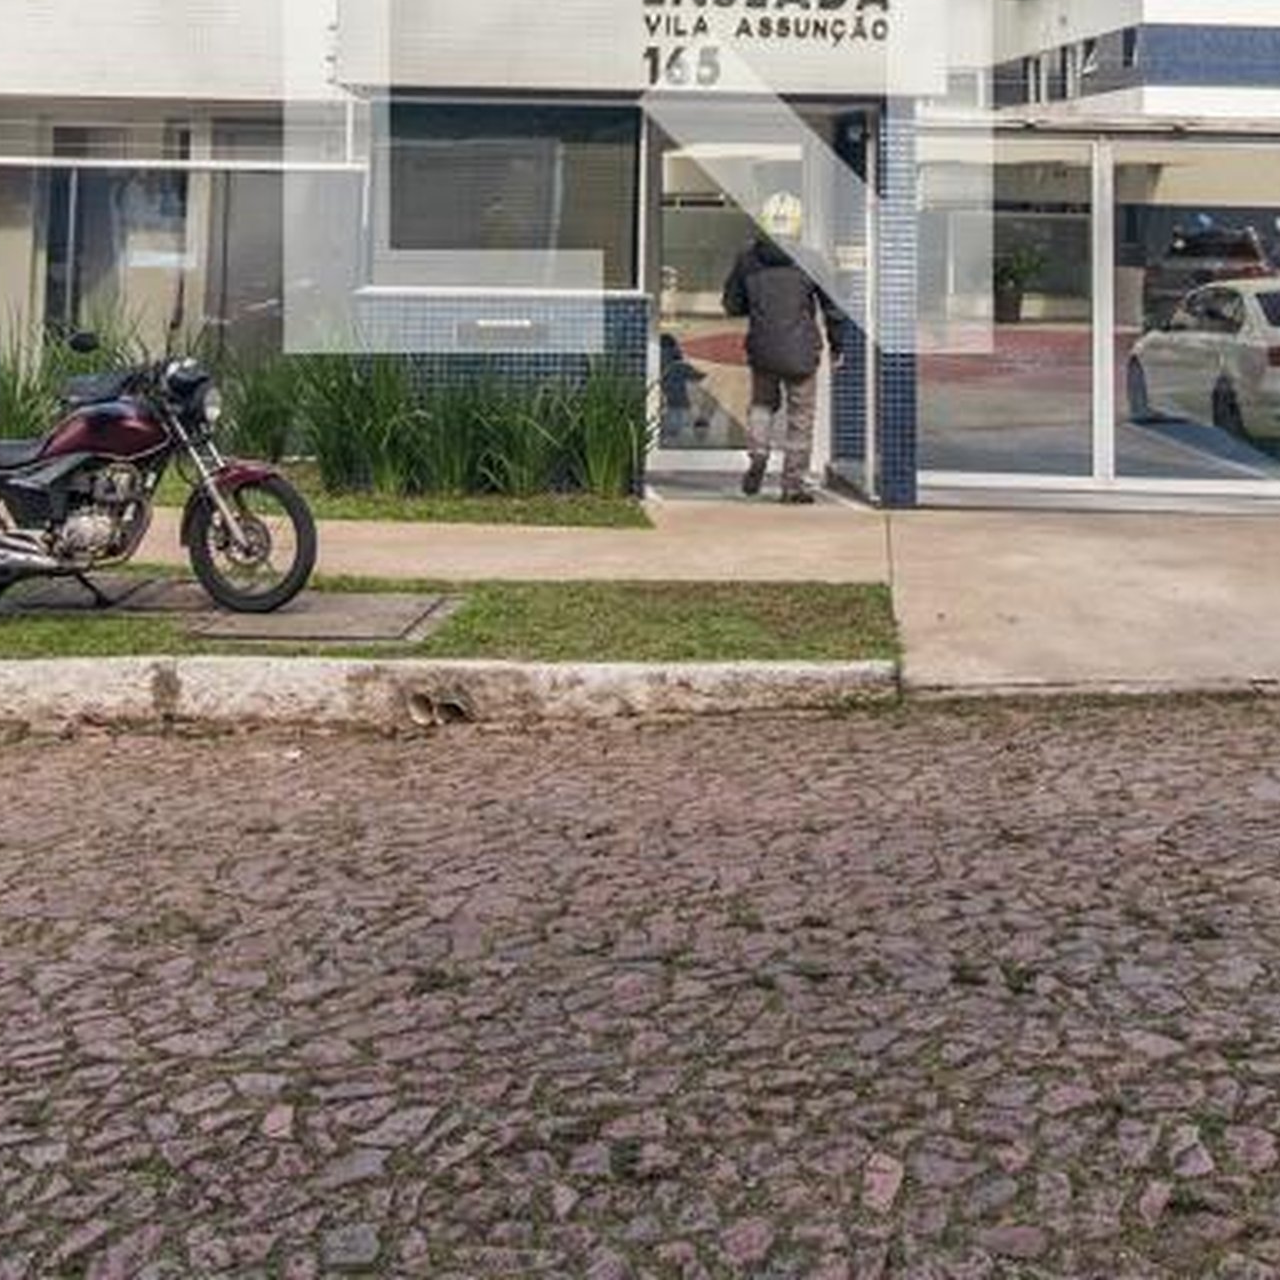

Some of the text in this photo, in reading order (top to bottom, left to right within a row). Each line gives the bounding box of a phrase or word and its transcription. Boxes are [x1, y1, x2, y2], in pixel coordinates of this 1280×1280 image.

[644, 15, 889, 47] VILA ASSUNÇÃO
[642, 46, 721, 85] 165
